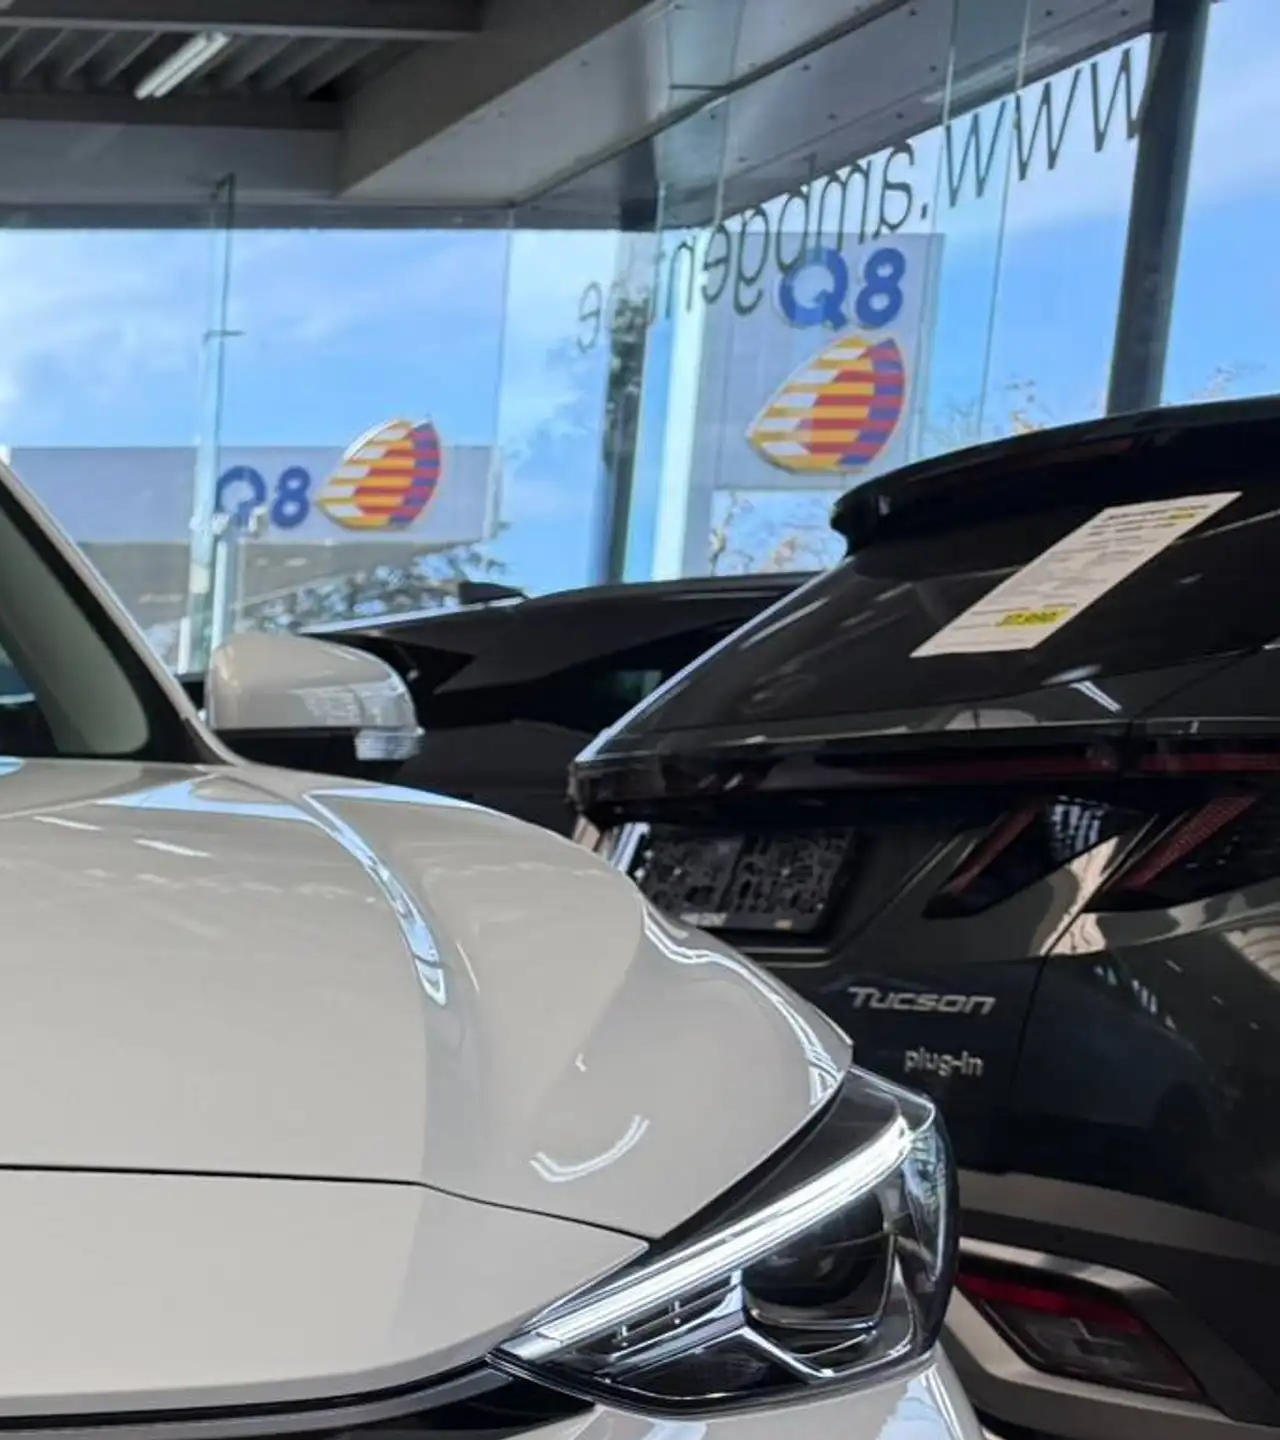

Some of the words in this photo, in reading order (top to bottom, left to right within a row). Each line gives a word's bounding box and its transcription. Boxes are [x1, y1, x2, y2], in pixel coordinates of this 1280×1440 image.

[779, 247, 906, 331] Q8
[215, 465, 311, 529] Q8
[904, 1046, 983, 1077] plug-in
